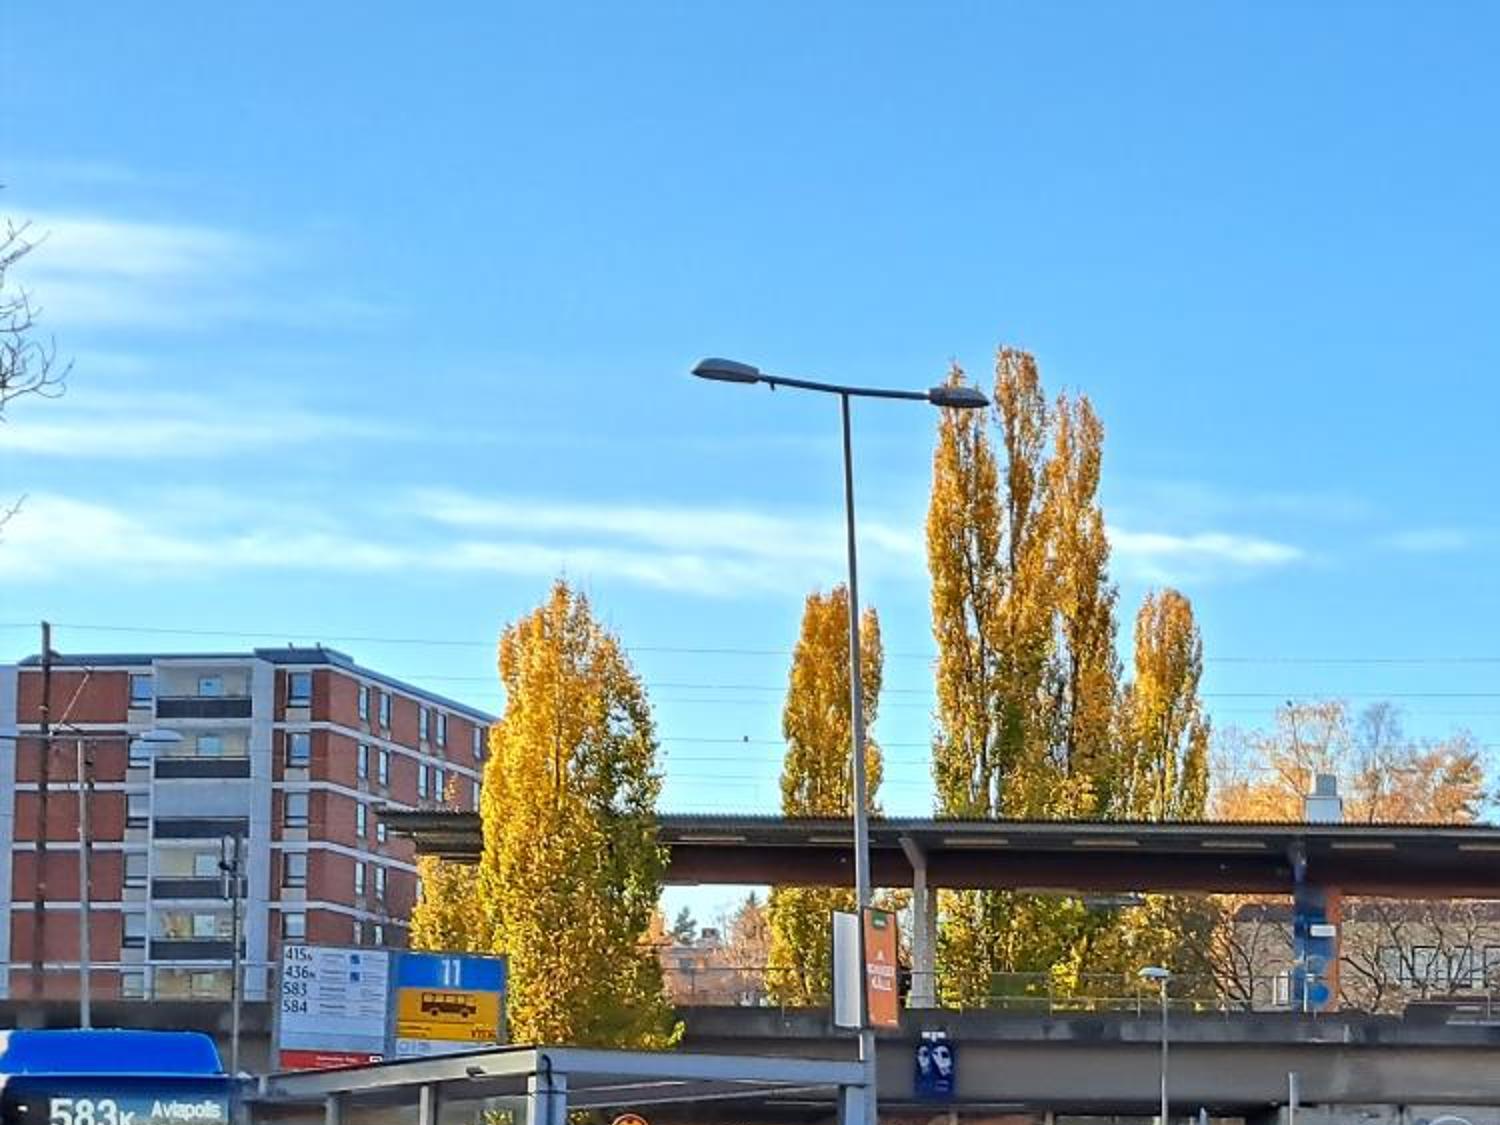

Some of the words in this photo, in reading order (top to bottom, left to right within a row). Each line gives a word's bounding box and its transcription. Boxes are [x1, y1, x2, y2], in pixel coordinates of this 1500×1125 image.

[441, 958, 462, 987] 11
[283, 981, 308, 997] 583
[283, 999, 308, 1015] 584
